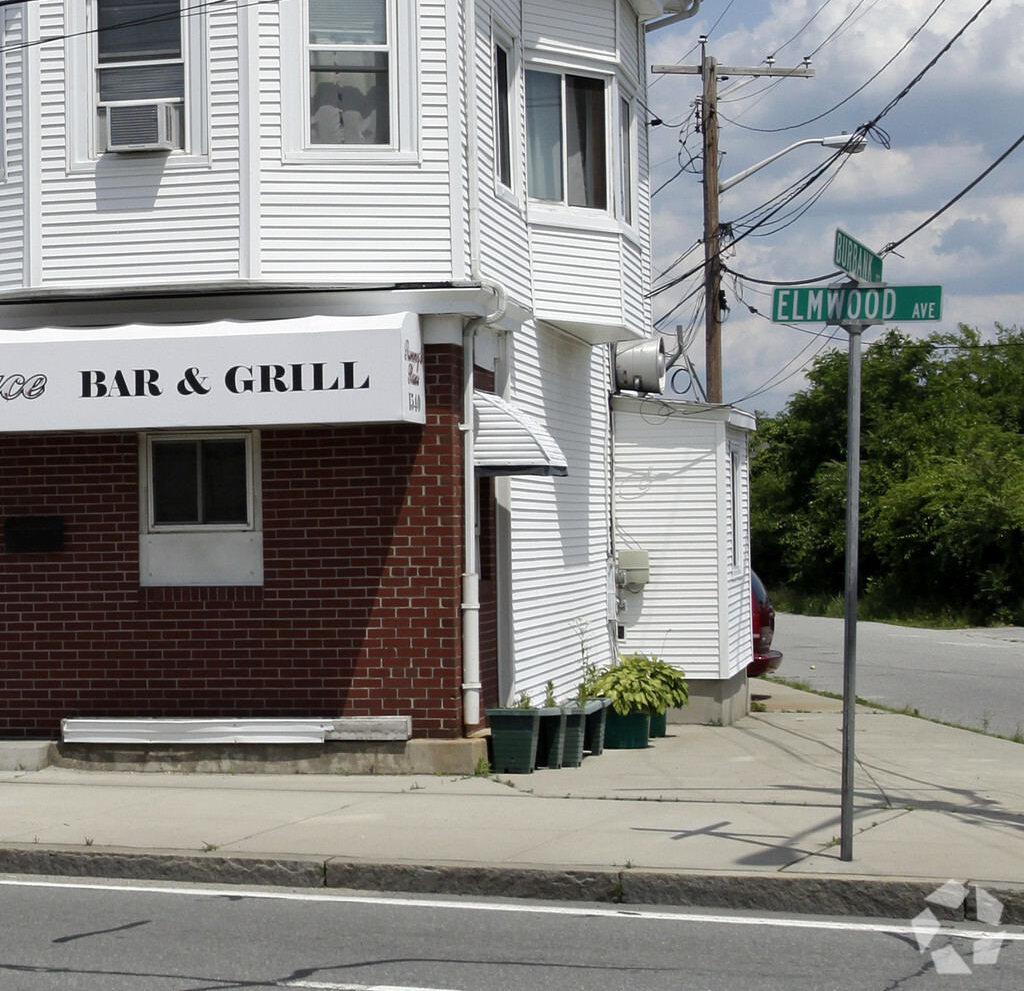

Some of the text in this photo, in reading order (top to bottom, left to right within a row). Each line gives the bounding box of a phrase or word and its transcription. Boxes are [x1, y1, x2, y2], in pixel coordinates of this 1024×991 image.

[835, 231, 874, 283] BURBANK
[777, 288, 936, 320] ELMWOOD AVE
[78, 361, 371, 399] BAR & GRILL
